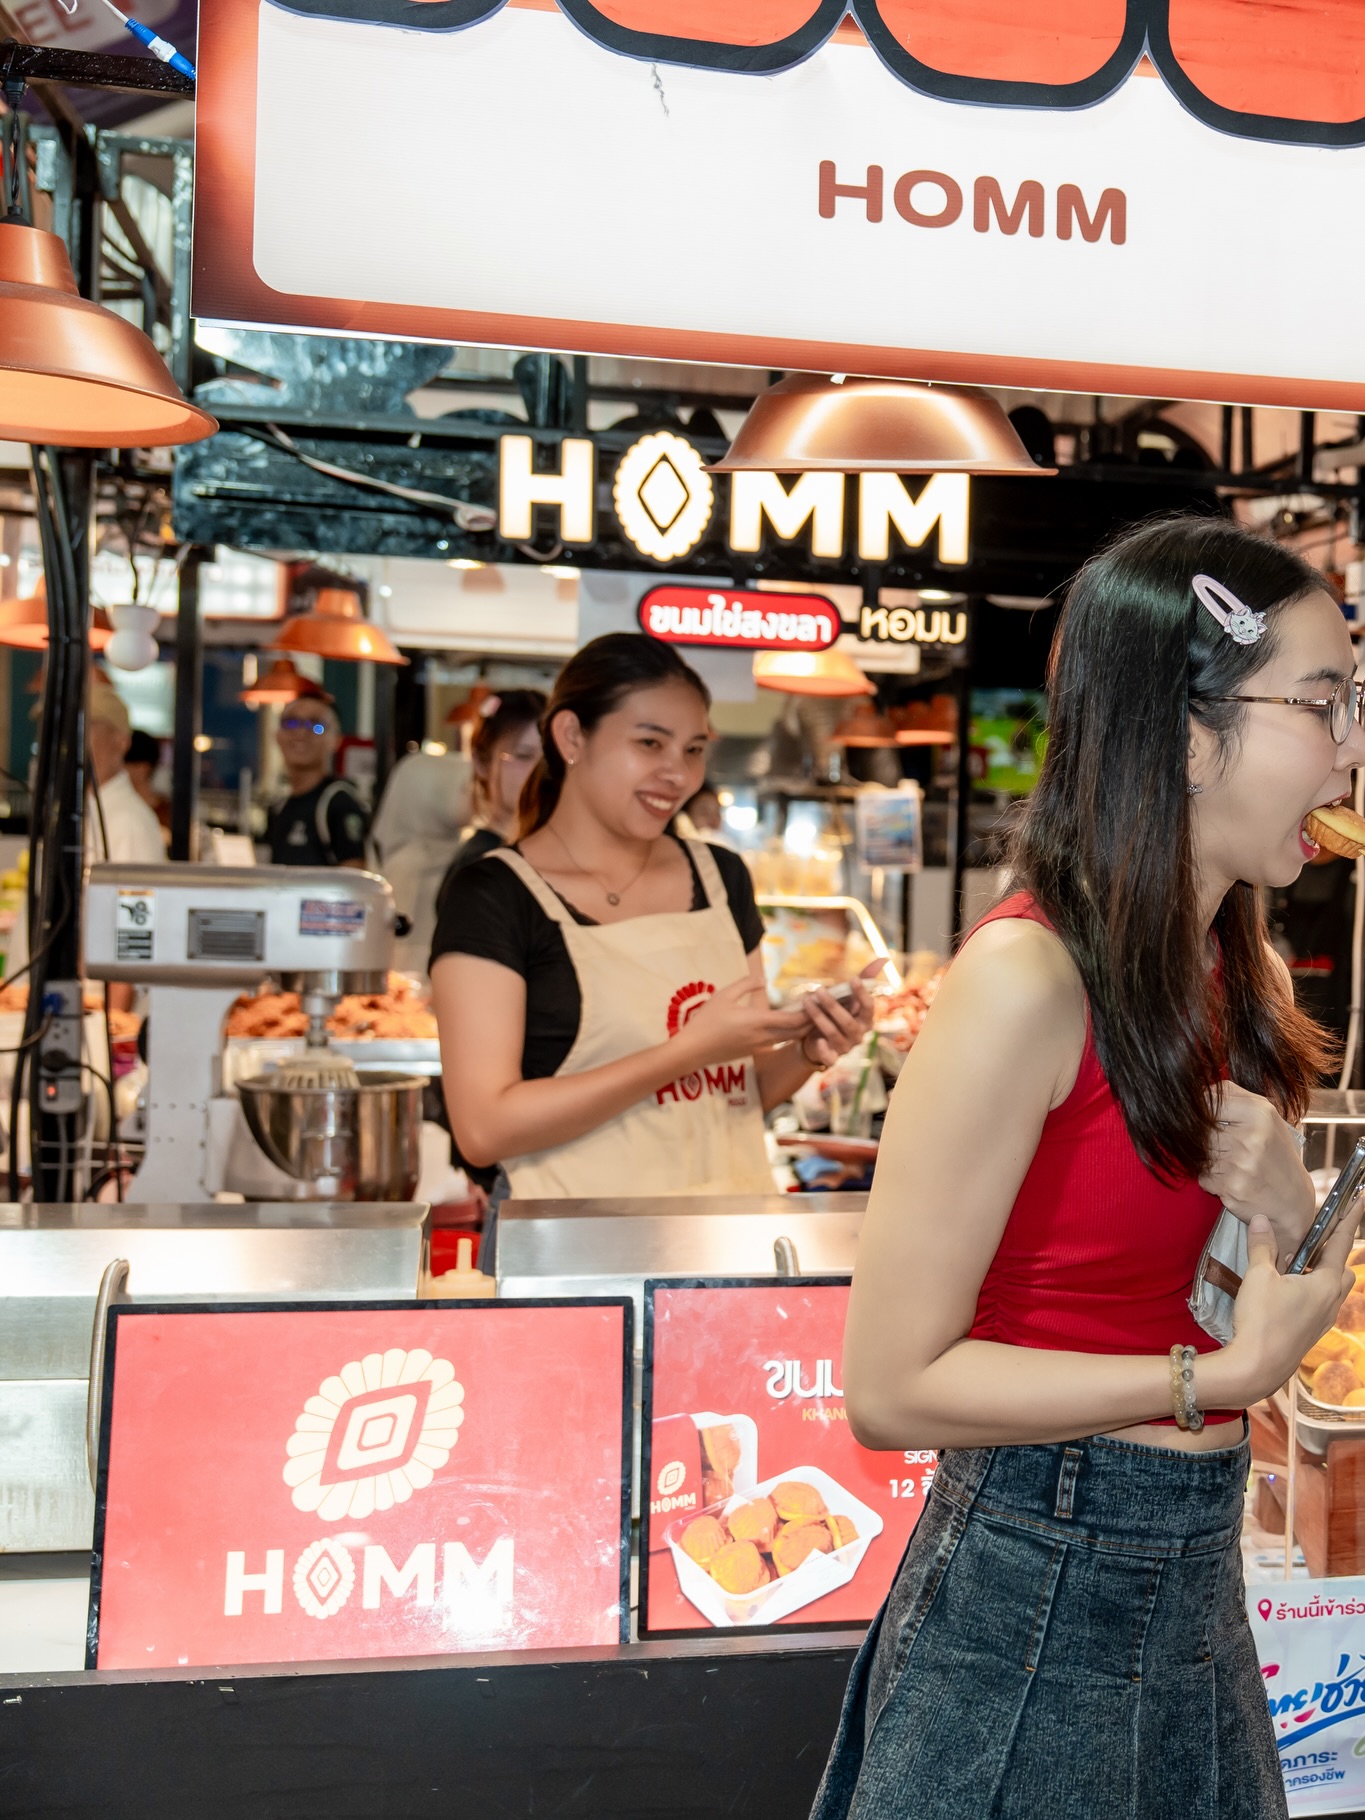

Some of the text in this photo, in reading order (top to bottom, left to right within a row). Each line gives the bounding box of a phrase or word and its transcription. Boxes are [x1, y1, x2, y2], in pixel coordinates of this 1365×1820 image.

[818, 160, 1127, 246] HOMM
[500, 431, 970, 565] HOMM
[649, 594, 832, 643] ขนมไข่สงขลา
[860, 606, 967, 644] หอมม
[650, 1492, 696, 1515] HOMM
[889, 1478, 915, 1499] 12
[223, 1537, 515, 1620] HOMM
[1281, 1751, 1338, 1769] ดภาระ
[1285, 1768, 1346, 1787] าครองชีพ
